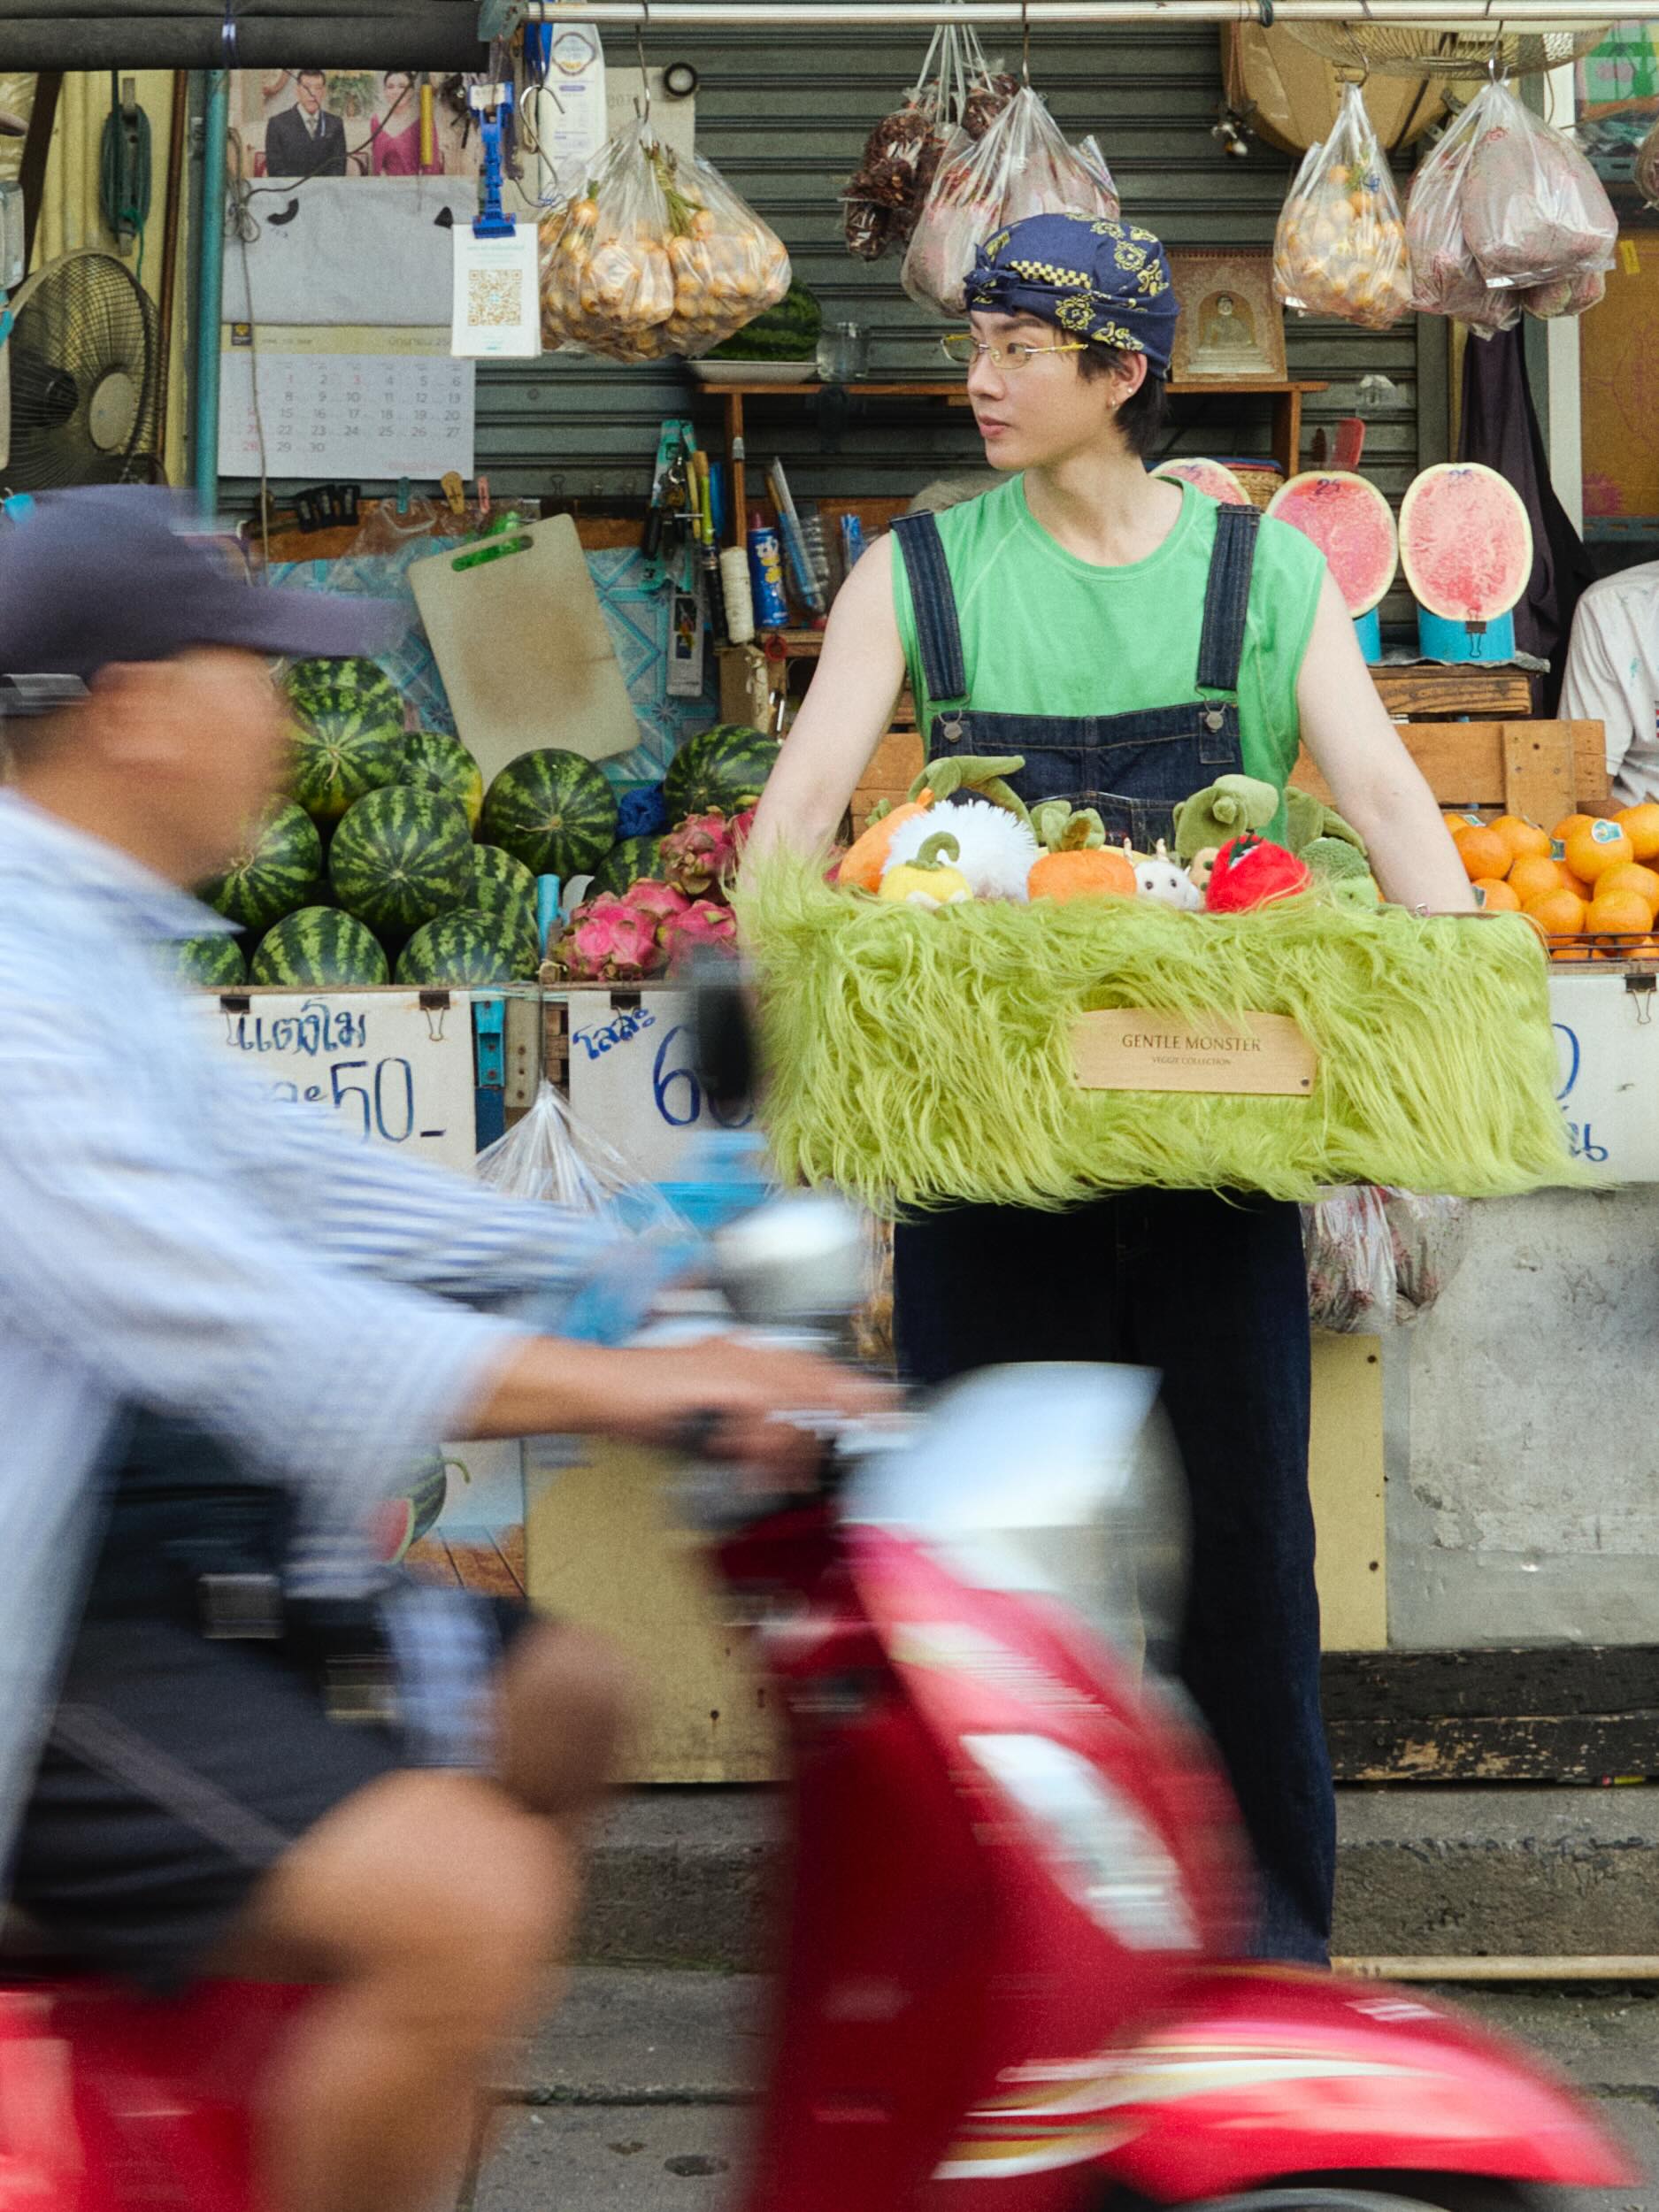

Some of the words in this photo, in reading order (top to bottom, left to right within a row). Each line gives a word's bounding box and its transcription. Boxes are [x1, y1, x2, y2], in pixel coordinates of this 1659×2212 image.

[319, 374, 327, 384] 2
[386, 376, 394, 386] 4
[420, 376, 427, 387] 5
[452, 376, 461, 387] 6
[285, 391, 293, 402] 8
[319, 391, 326, 402] 9
[346, 392, 361, 403] 10
[385, 392, 394, 403] 11
[416, 392, 428, 403] 12
[449, 393, 460, 404] 13
[281, 408, 293, 419] 15
[314, 409, 326, 419] 16
[349, 409, 360, 419] 17
[380, 410, 394, 420] 18
[414, 410, 426, 420] 19
[444, 411, 461, 421] 20
[277, 425, 292, 436] 22
[311, 426, 326, 436] 23
[344, 426, 359, 436] 24
[379, 426, 395, 437] 25
[411, 426, 426, 437] 26
[446, 426, 461, 438] 27
[276, 442, 292, 453] 29
[310, 442, 326, 453] 30
[1122, 1033, 1181, 1048] GENTLE
[1186, 1036, 1261, 1052] MONSTER
[1181, 1056, 1232, 1066] COLLECTION
